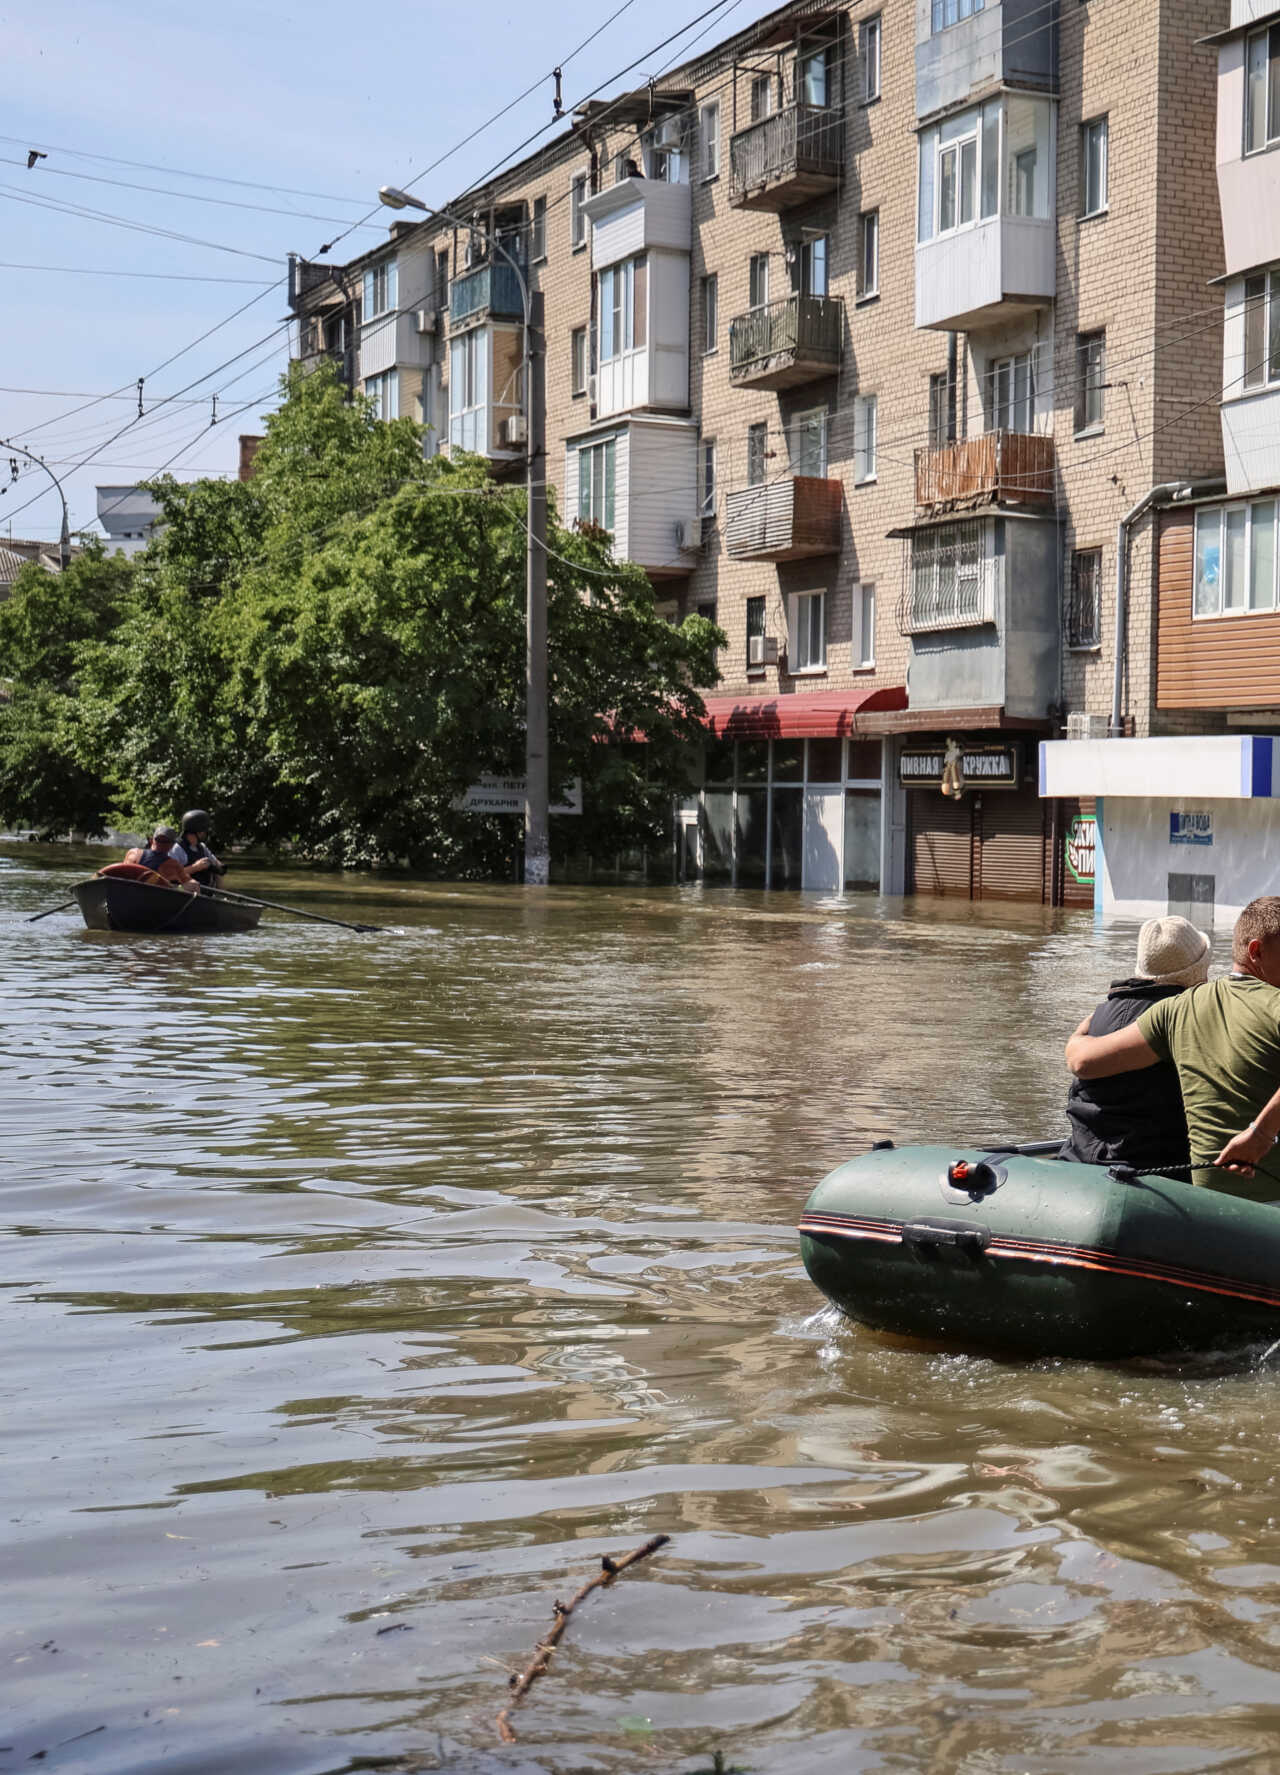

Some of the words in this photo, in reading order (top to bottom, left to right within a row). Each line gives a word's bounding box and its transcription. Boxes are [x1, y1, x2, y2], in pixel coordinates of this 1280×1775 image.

[900, 756, 939, 775] ПИВНАЯ
[963, 755, 1006, 776] КРУЖКА
[470, 799, 519, 808] ДРУКАРНЯ
